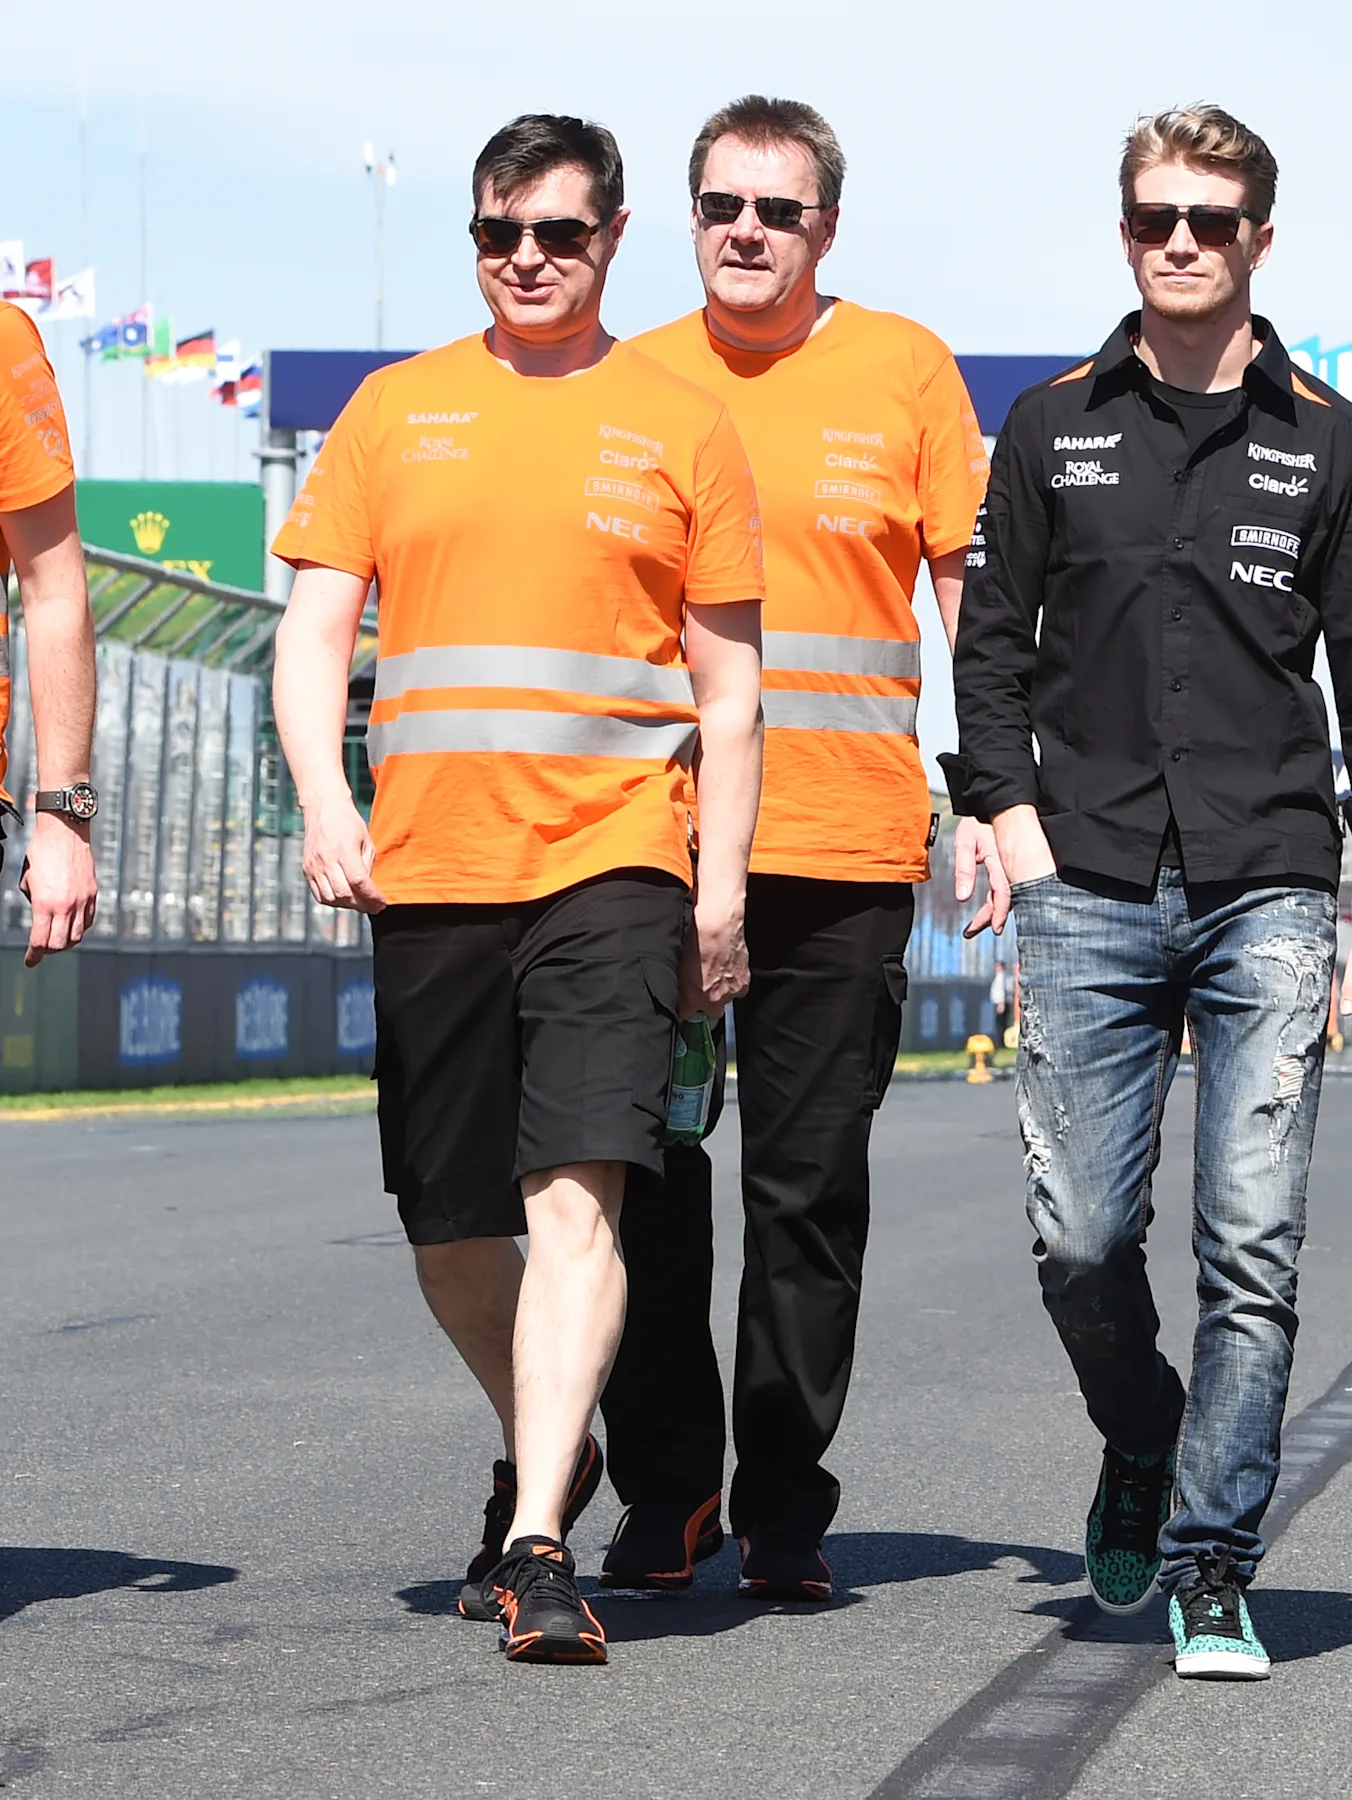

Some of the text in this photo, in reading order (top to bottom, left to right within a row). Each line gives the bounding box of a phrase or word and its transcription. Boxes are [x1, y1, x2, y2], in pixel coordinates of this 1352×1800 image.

[407, 412, 473, 424] SAHARA
[419, 436, 454, 448] ROYAL
[599, 424, 663, 457] KINGFISHER
[822, 428, 885, 449] KINGFISHER
[1053, 434, 1117, 451] SAHARA
[599, 449, 650, 471] Claro
[825, 453, 870, 470] Claro
[1065, 460, 1104, 474] ROYAL
[1247, 442, 1317, 472] KINGFISHER
[1051, 472, 1119, 489] CHALLENGE
[1248, 473, 1300, 497] Claro
[592, 481, 653, 505] SMIRNOFF
[822, 484, 876, 502] SMIRNOFF
[586, 511, 650, 544] NEC
[816, 513, 875, 539] NEC
[1239, 529, 1299, 553] SMIRNOFF
[1230, 561, 1294, 592] NEC
